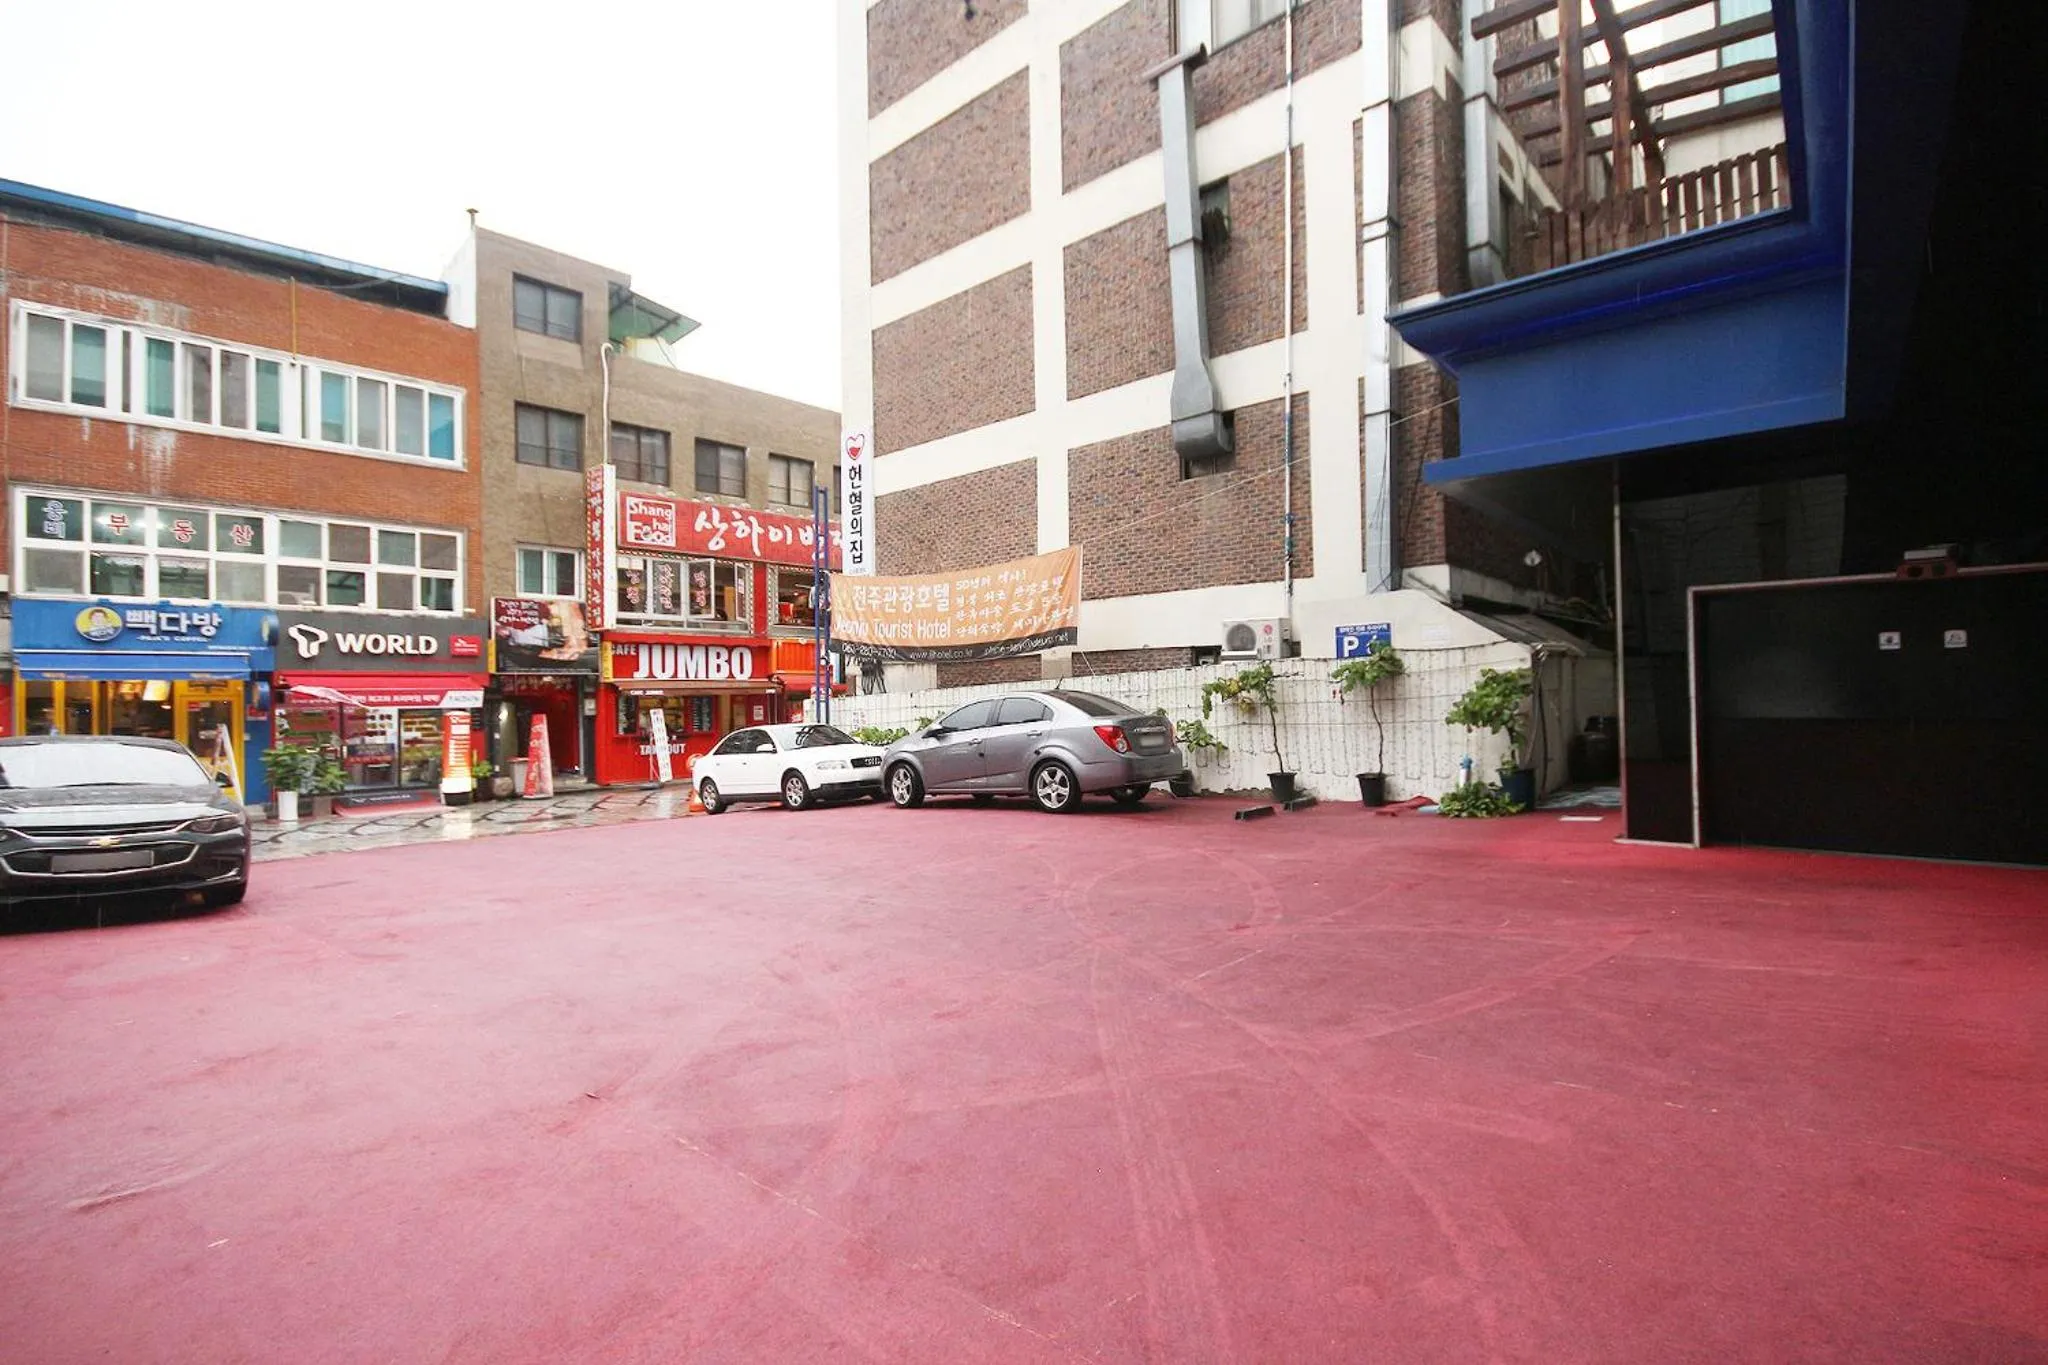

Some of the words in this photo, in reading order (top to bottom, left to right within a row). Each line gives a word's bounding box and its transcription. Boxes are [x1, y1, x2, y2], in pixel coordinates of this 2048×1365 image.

[848, 464, 863, 564] 헌혈의집
[853, 583, 950, 613] 전주관광호텔
[125, 609, 223, 636] 빽다방
[874, 618, 914, 638] Tourist
[917, 617, 951, 638] Hotel
[335, 633, 438, 655] WORLD
[1343, 635, 1359, 657] P
[611, 644, 637, 656] CAFE
[633, 643, 753, 680] JUMBO
